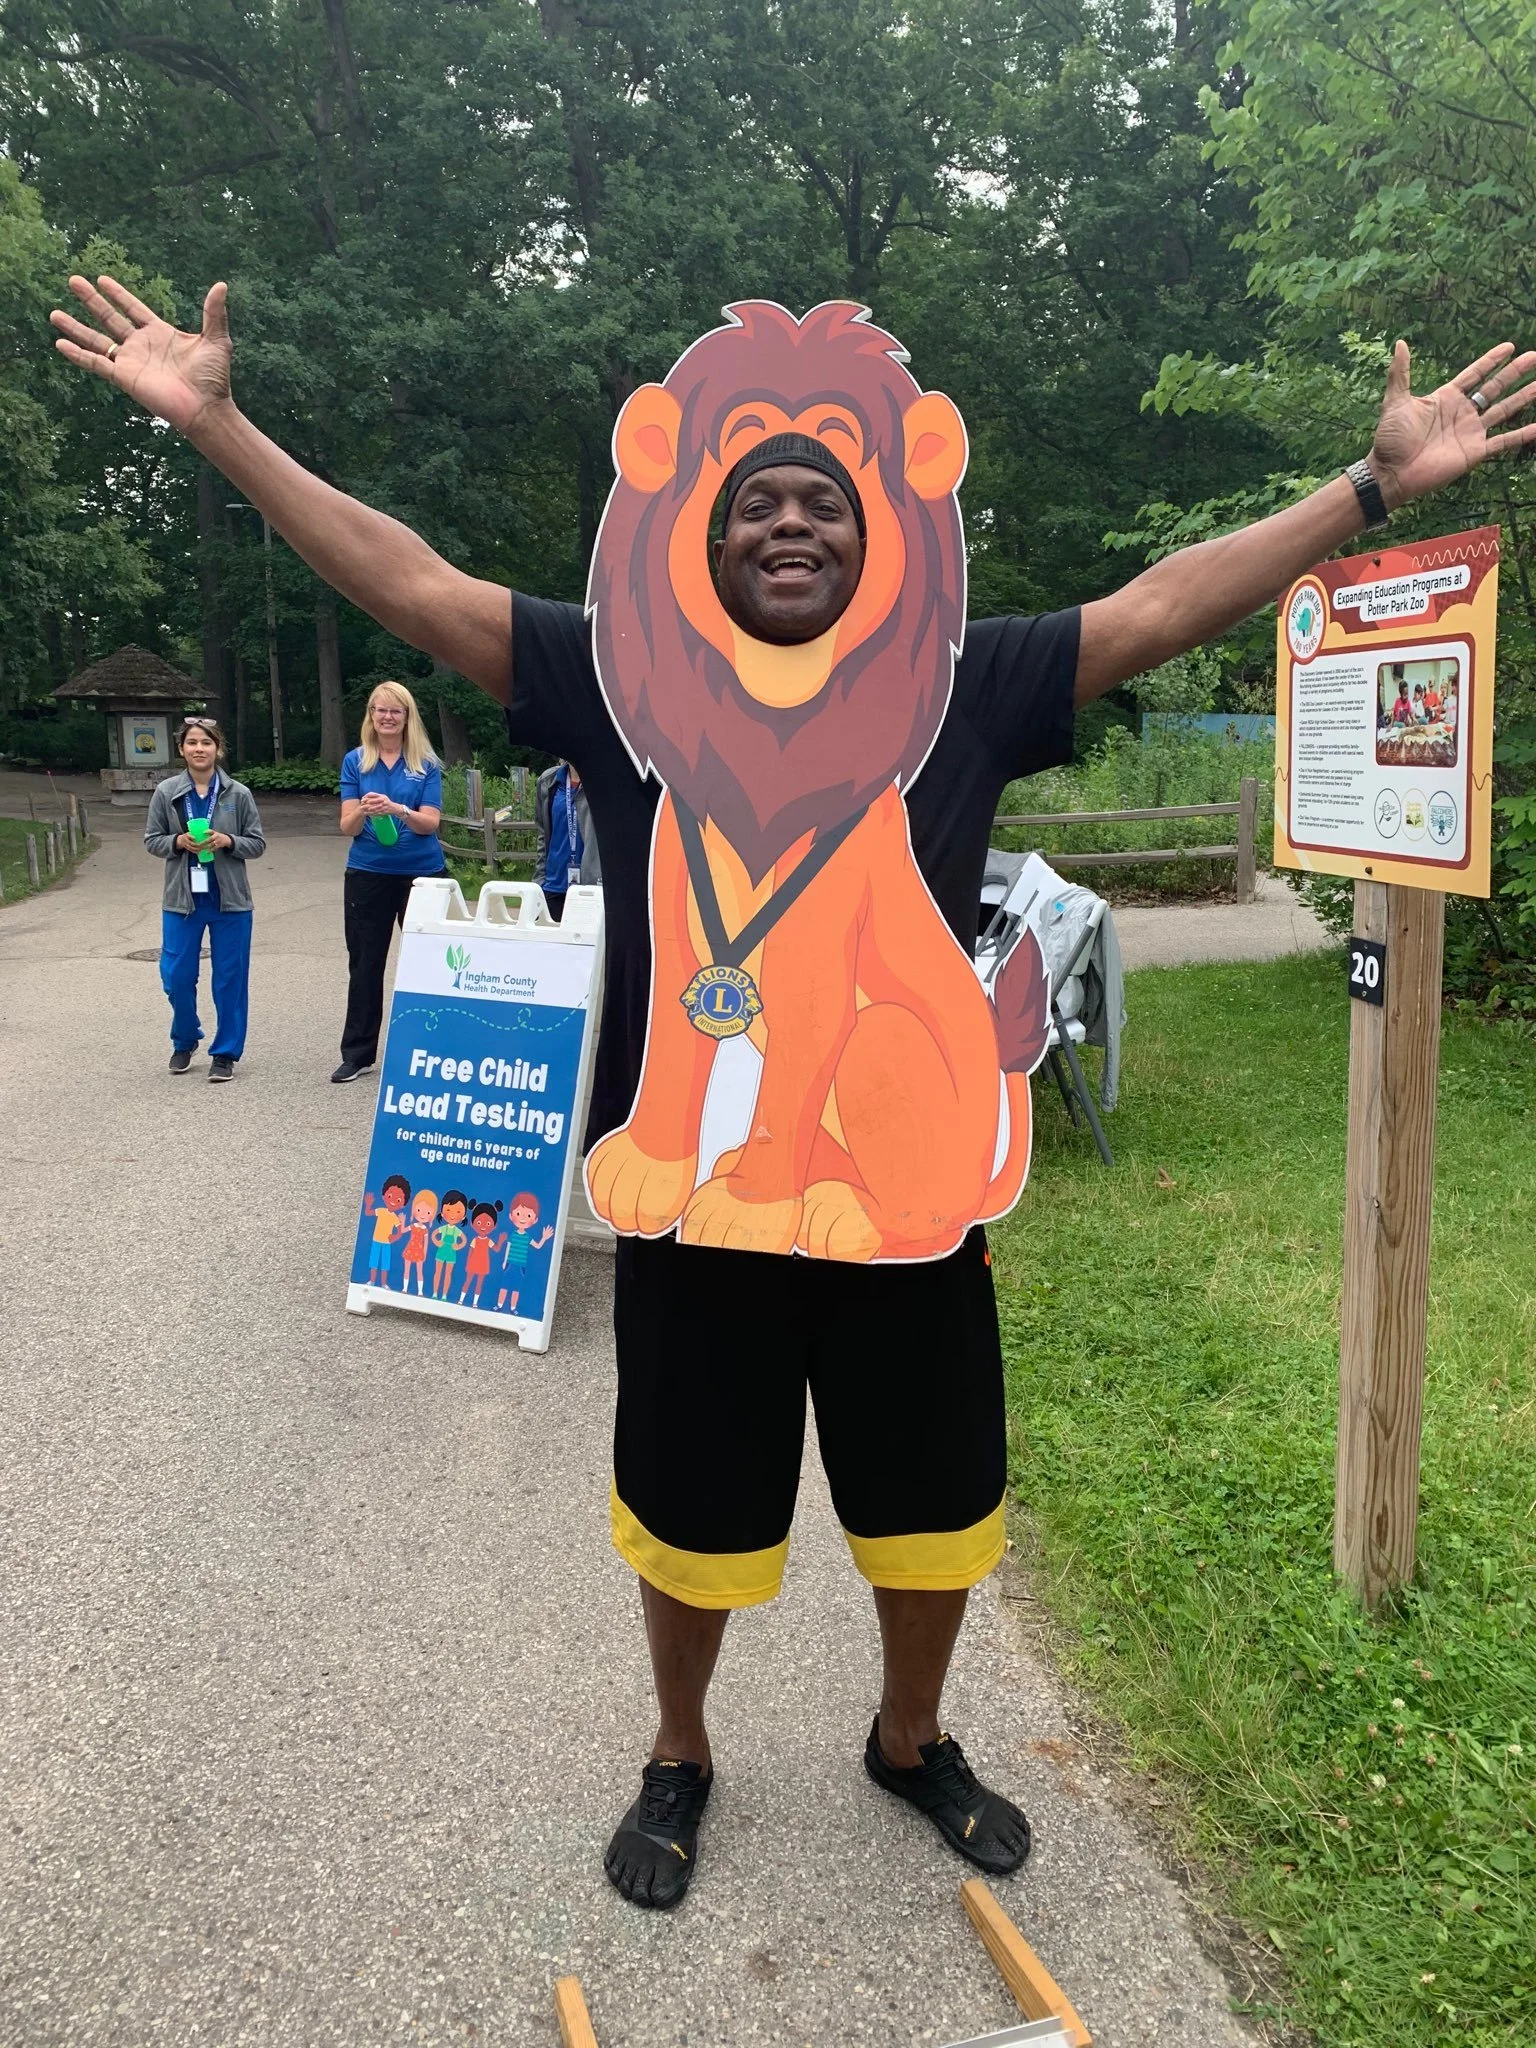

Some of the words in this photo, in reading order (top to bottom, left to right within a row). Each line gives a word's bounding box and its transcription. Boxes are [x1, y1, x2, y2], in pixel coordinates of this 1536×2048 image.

[1337, 588, 1373, 605] Expanding
[1374, 581, 1410, 598] Education
[1412, 575, 1452, 593] Programs
[1453, 571, 1463, 585] at
[1291, 592, 1304, 619] POTTER
[1304, 590, 1316, 602] PARK
[1313, 600, 1322, 616] ZOO
[1367, 602, 1389, 616] Potter
[1390, 599, 1409, 613] Park
[1410, 596, 1425, 610] Zoo
[1303, 635, 1318, 654] YEARS
[465, 970, 501, 984] Ingham
[503, 974, 538, 989] County
[701, 968, 748, 987] LIONS
[1351, 951, 1380, 988] 20
[463, 983, 488, 993] Health
[490, 985, 536, 998] Department
[712, 987, 733, 1014] L
[697, 1017, 743, 1034] INTERNATIONAL
[408, 1048, 474, 1083] Free
[478, 1056, 549, 1093] Child
[383, 1084, 451, 1121] Lead
[455, 1094, 565, 1145] Testing
[396, 1127, 417, 1142] for
[418, 1131, 472, 1150] children
[474, 1139, 483, 1152] 6
[485, 1142, 523, 1158] years
[525, 1148, 541, 1160] of
[420, 1147, 444, 1163] age
[445, 1152, 470, 1165] and
[471, 1155, 511, 1171] under
